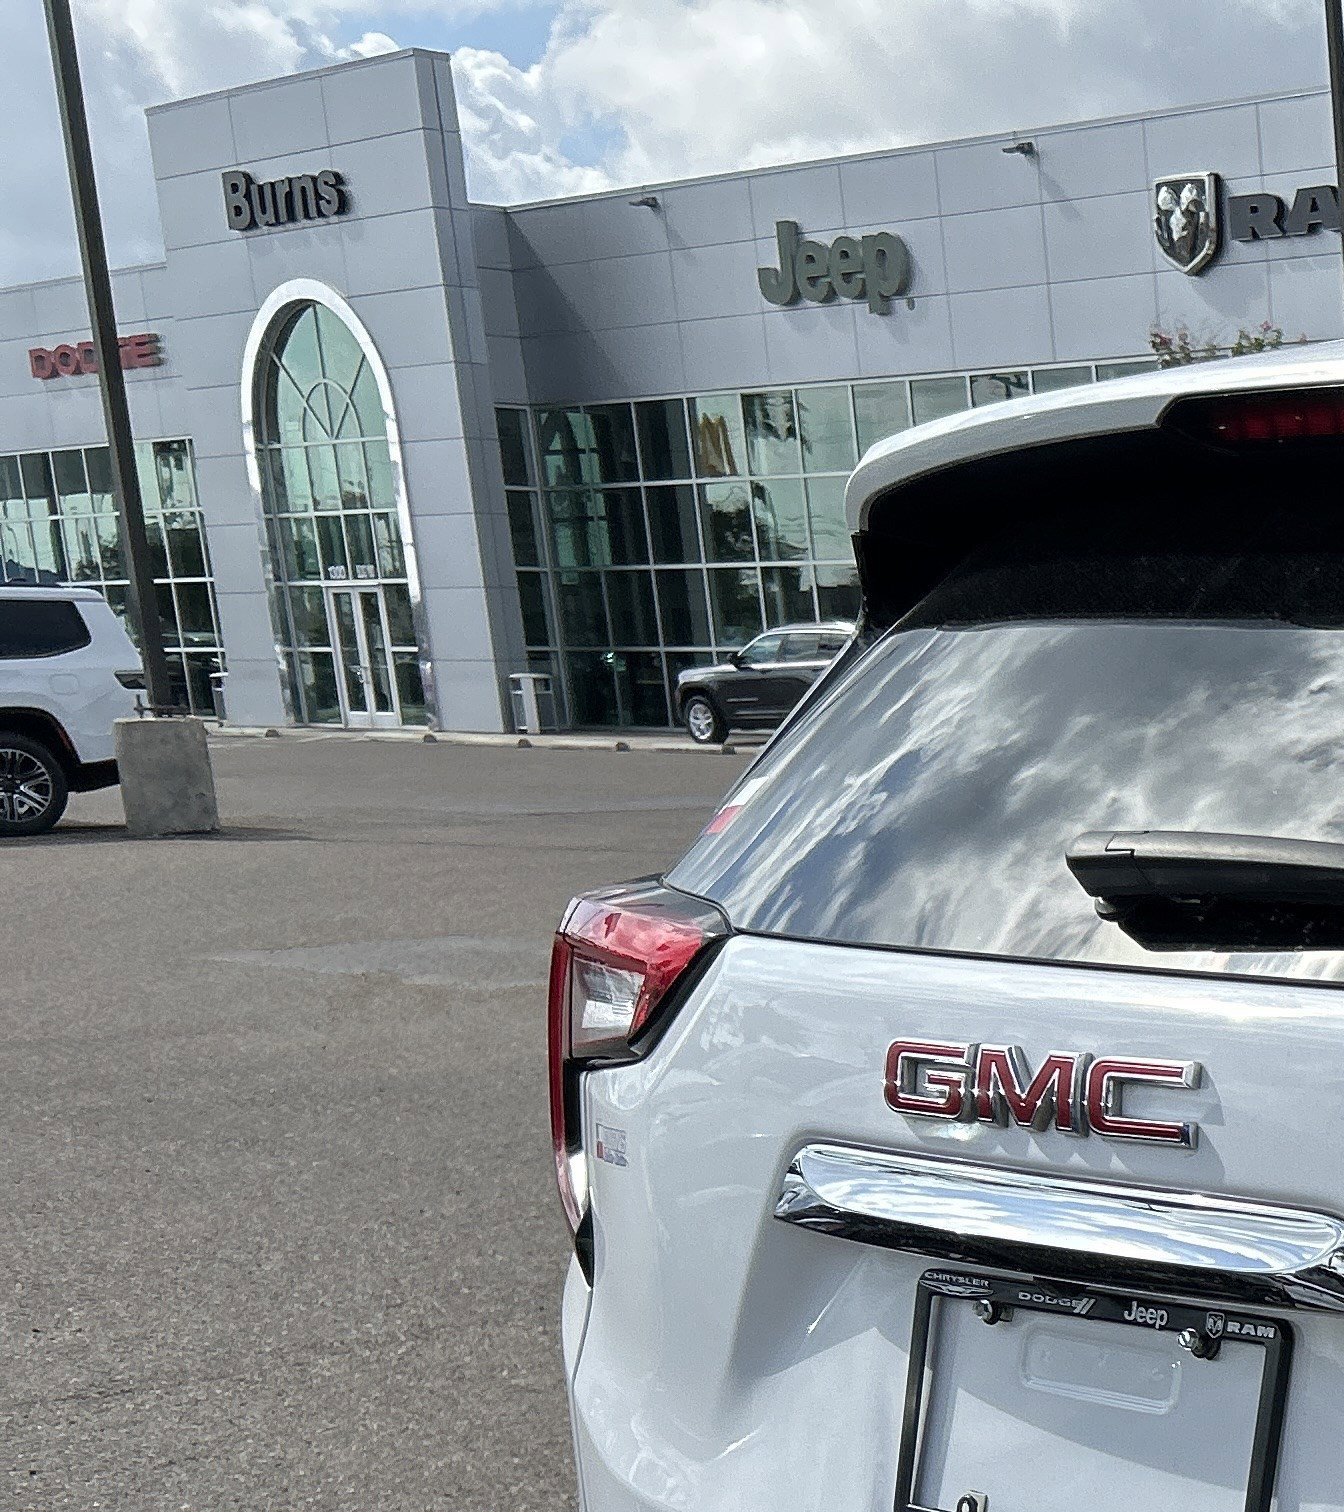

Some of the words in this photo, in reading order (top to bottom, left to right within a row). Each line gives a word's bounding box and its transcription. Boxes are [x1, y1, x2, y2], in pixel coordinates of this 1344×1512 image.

[222, 170, 343, 230] Burns
[758, 220, 911, 315] Jeep
[883, 1037, 1203, 1150] GMC
[924, 1271, 990, 1288] CHRYSLER
[1123, 1300, 1169, 1330] Jeep
[1226, 1320, 1276, 1339] RAM
